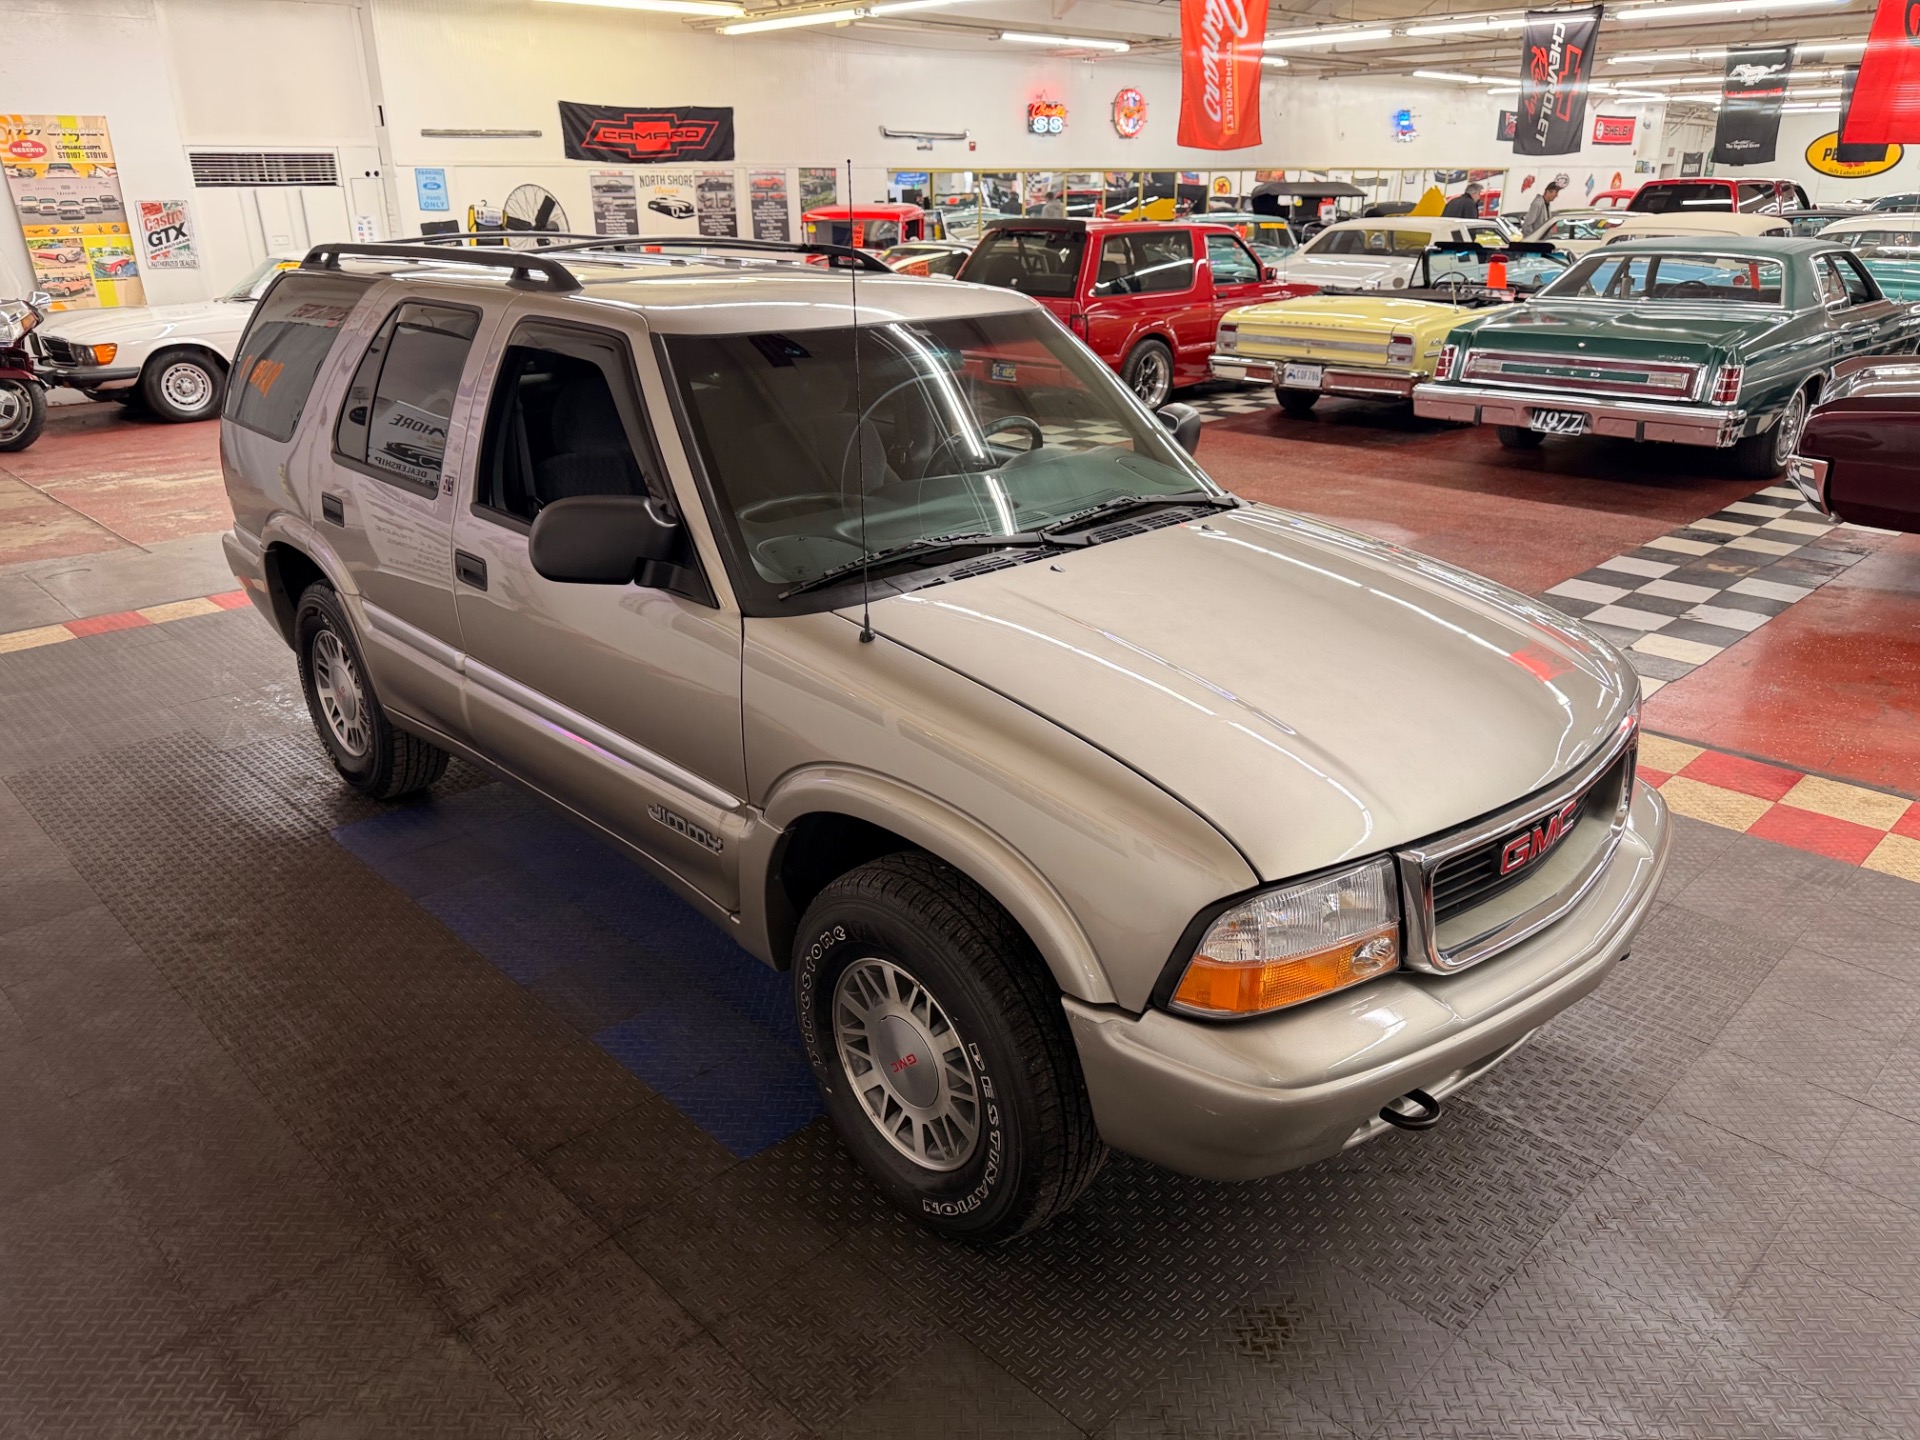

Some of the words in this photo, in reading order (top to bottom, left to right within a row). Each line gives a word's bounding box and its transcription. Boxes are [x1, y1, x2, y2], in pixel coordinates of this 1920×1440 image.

[1536, 23, 1566, 147] CHEVROLET
[602, 129, 700, 141] CAMARO
[1032, 116, 1063, 133] SS
[1604, 125, 1631, 136] SHELBY
[640, 174, 666, 188] NORTH
[667, 174, 694, 188] SHORE
[148, 221, 188, 247] GTX
[1533, 410, 1584, 434] 1977
[1500, 799, 1577, 876] GMC
[890, 1053, 917, 1073] GMC
[922, 1042, 1001, 1216] DESTINATION
